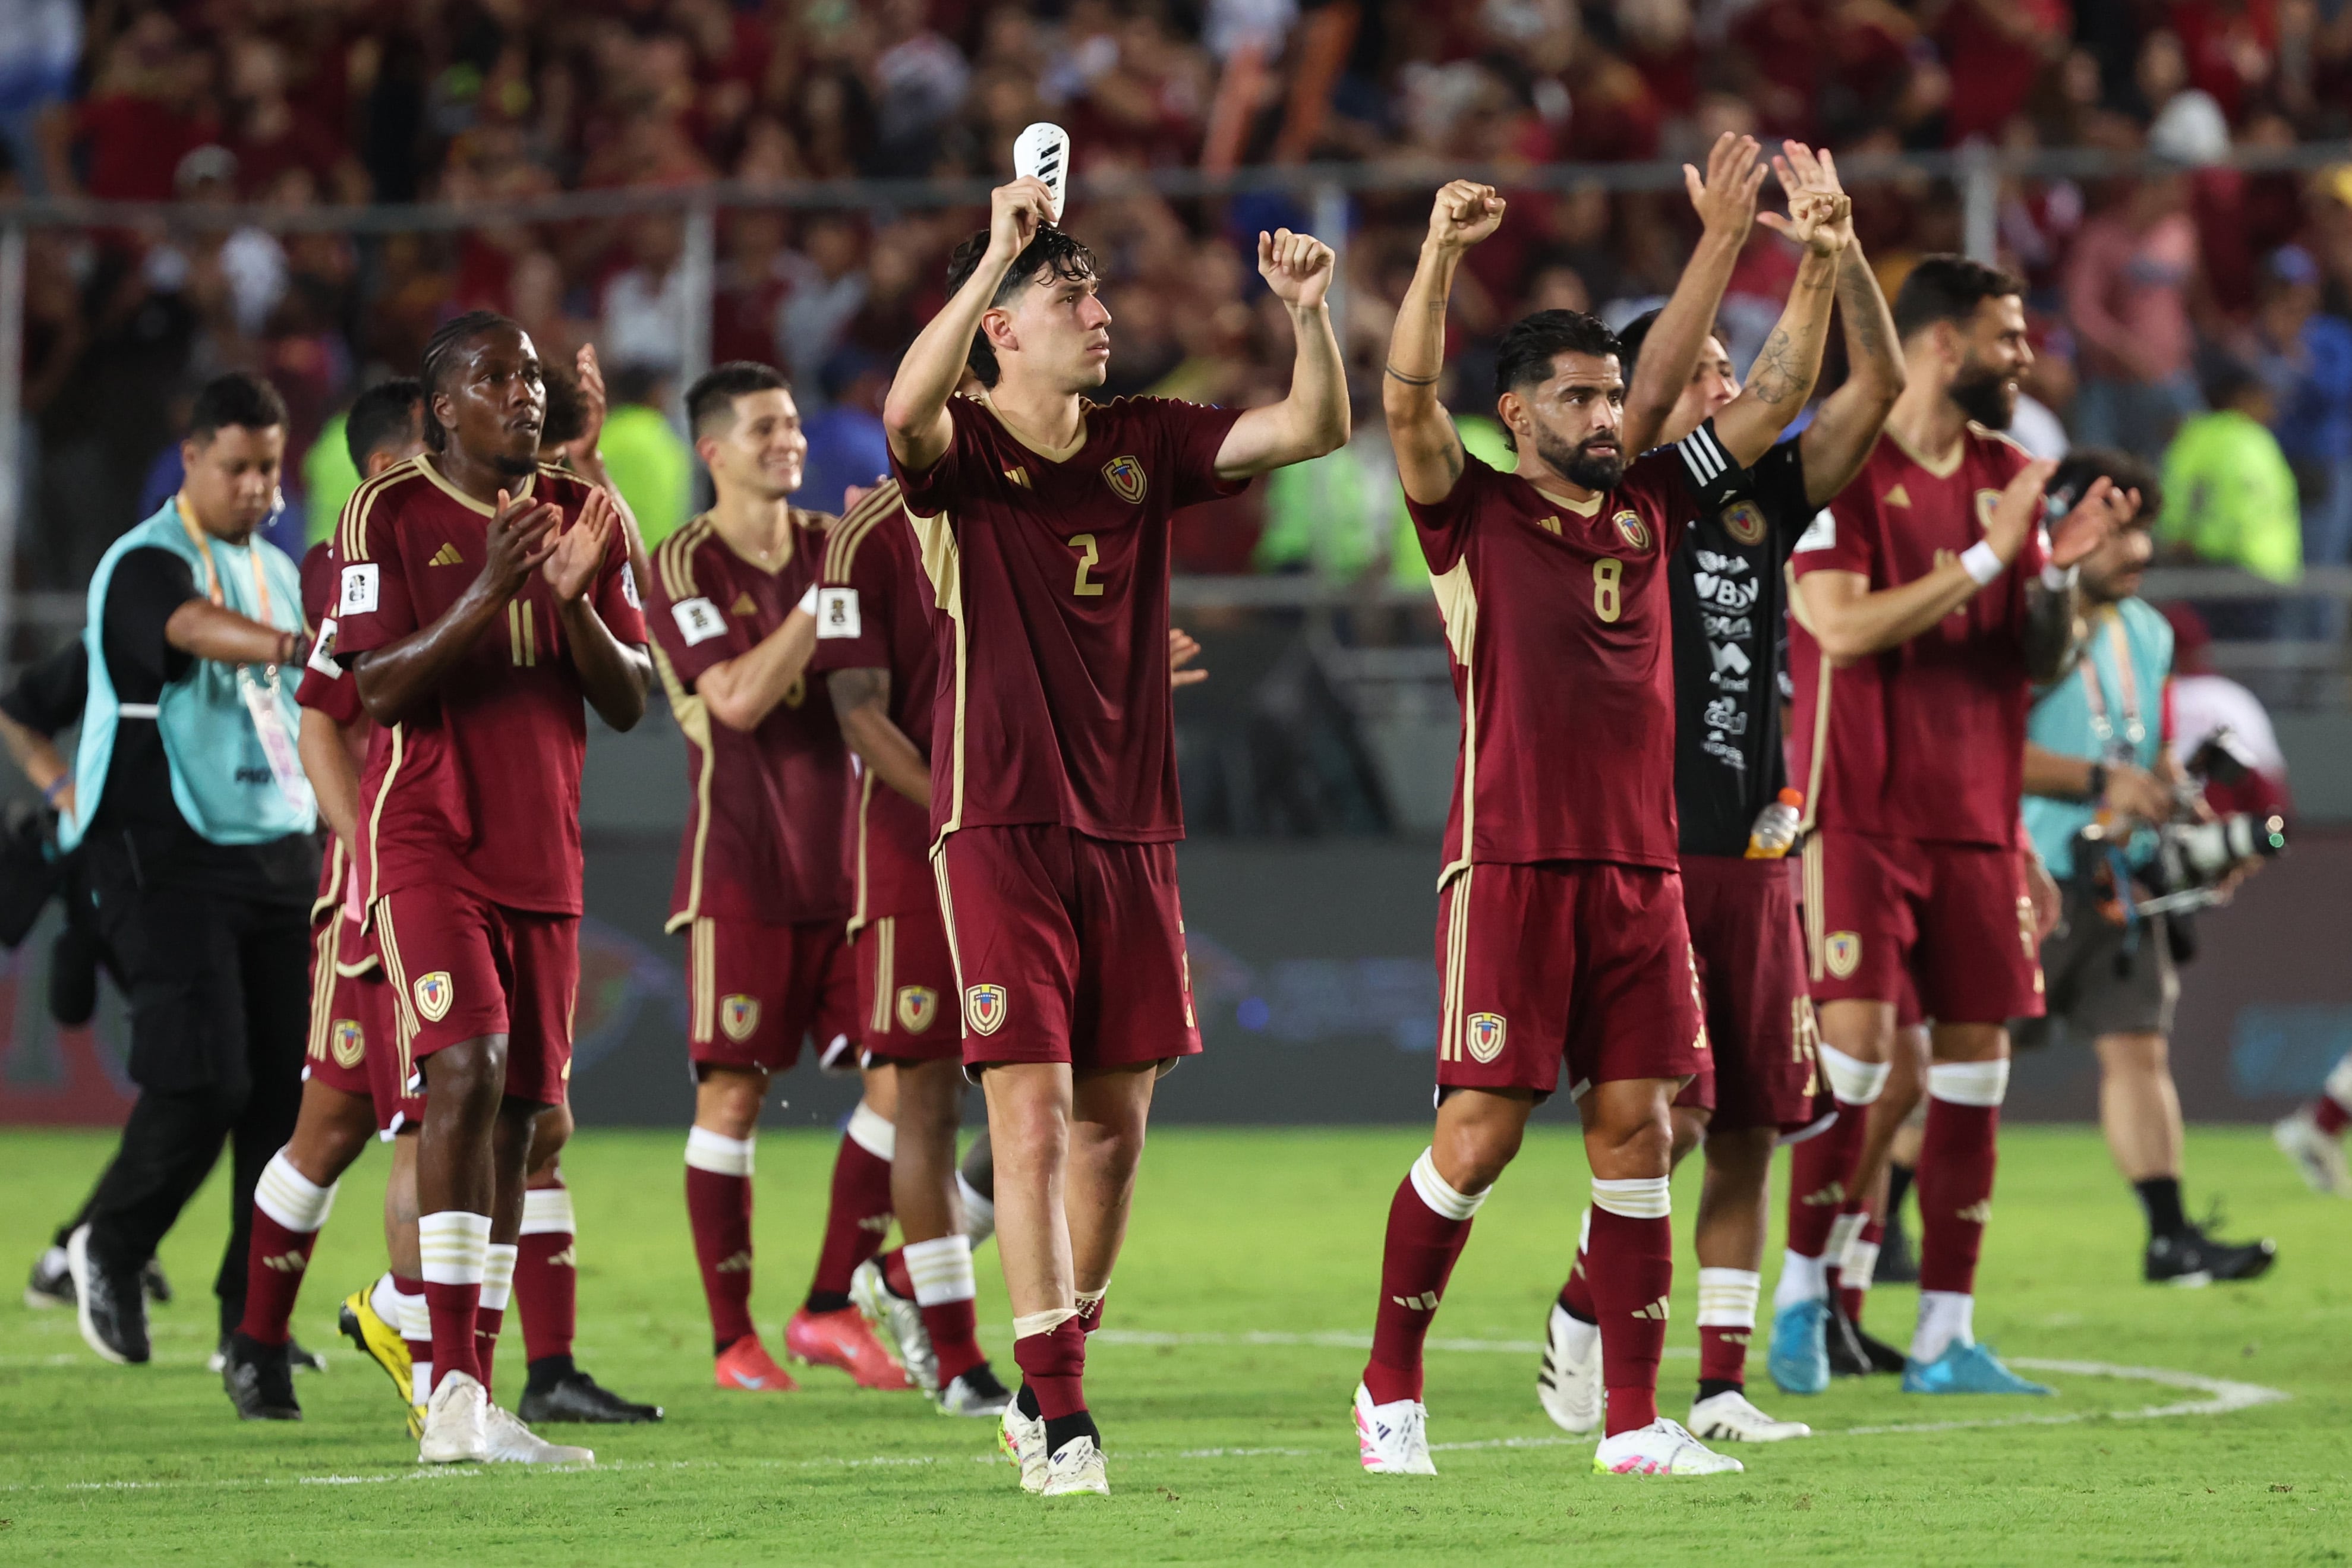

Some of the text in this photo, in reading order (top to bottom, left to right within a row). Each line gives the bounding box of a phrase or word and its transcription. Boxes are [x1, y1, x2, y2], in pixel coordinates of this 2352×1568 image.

[1068, 534, 1104, 596] 2
[1593, 558, 1623, 623] 8
[507, 598, 536, 667] 11
